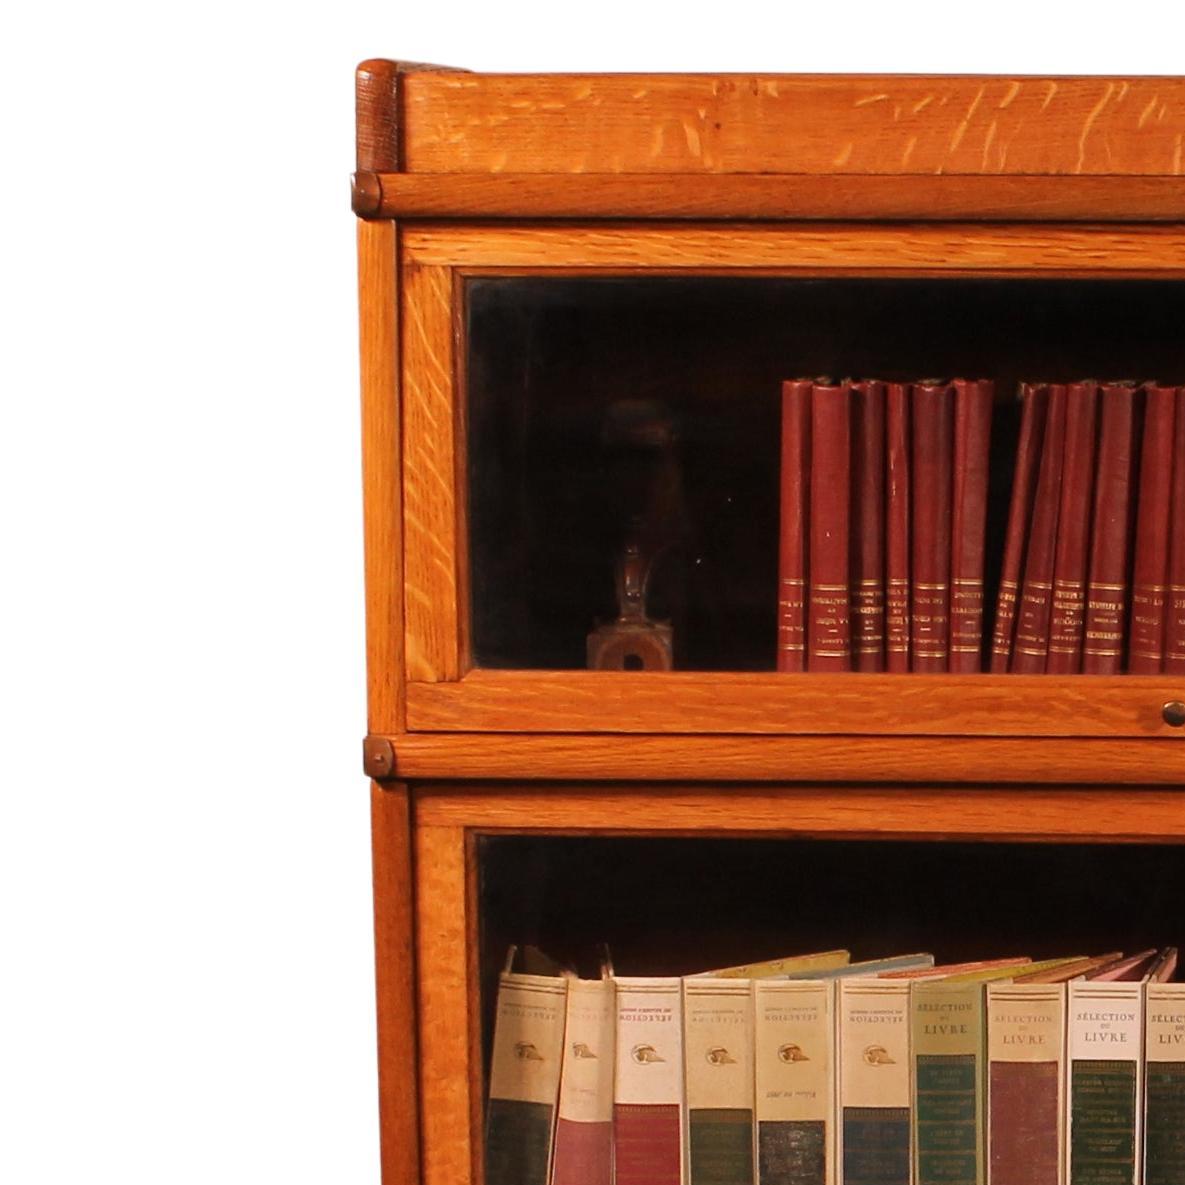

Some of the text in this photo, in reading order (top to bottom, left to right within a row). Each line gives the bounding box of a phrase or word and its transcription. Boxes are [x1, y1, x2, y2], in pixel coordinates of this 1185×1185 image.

[1076, 1011, 1135, 1022] SÉLECTION
[924, 1024, 969, 1035] LIVRE
[1003, 1034, 1046, 1045] LIVRE
[1085, 1032, 1128, 1043] LIVRE
